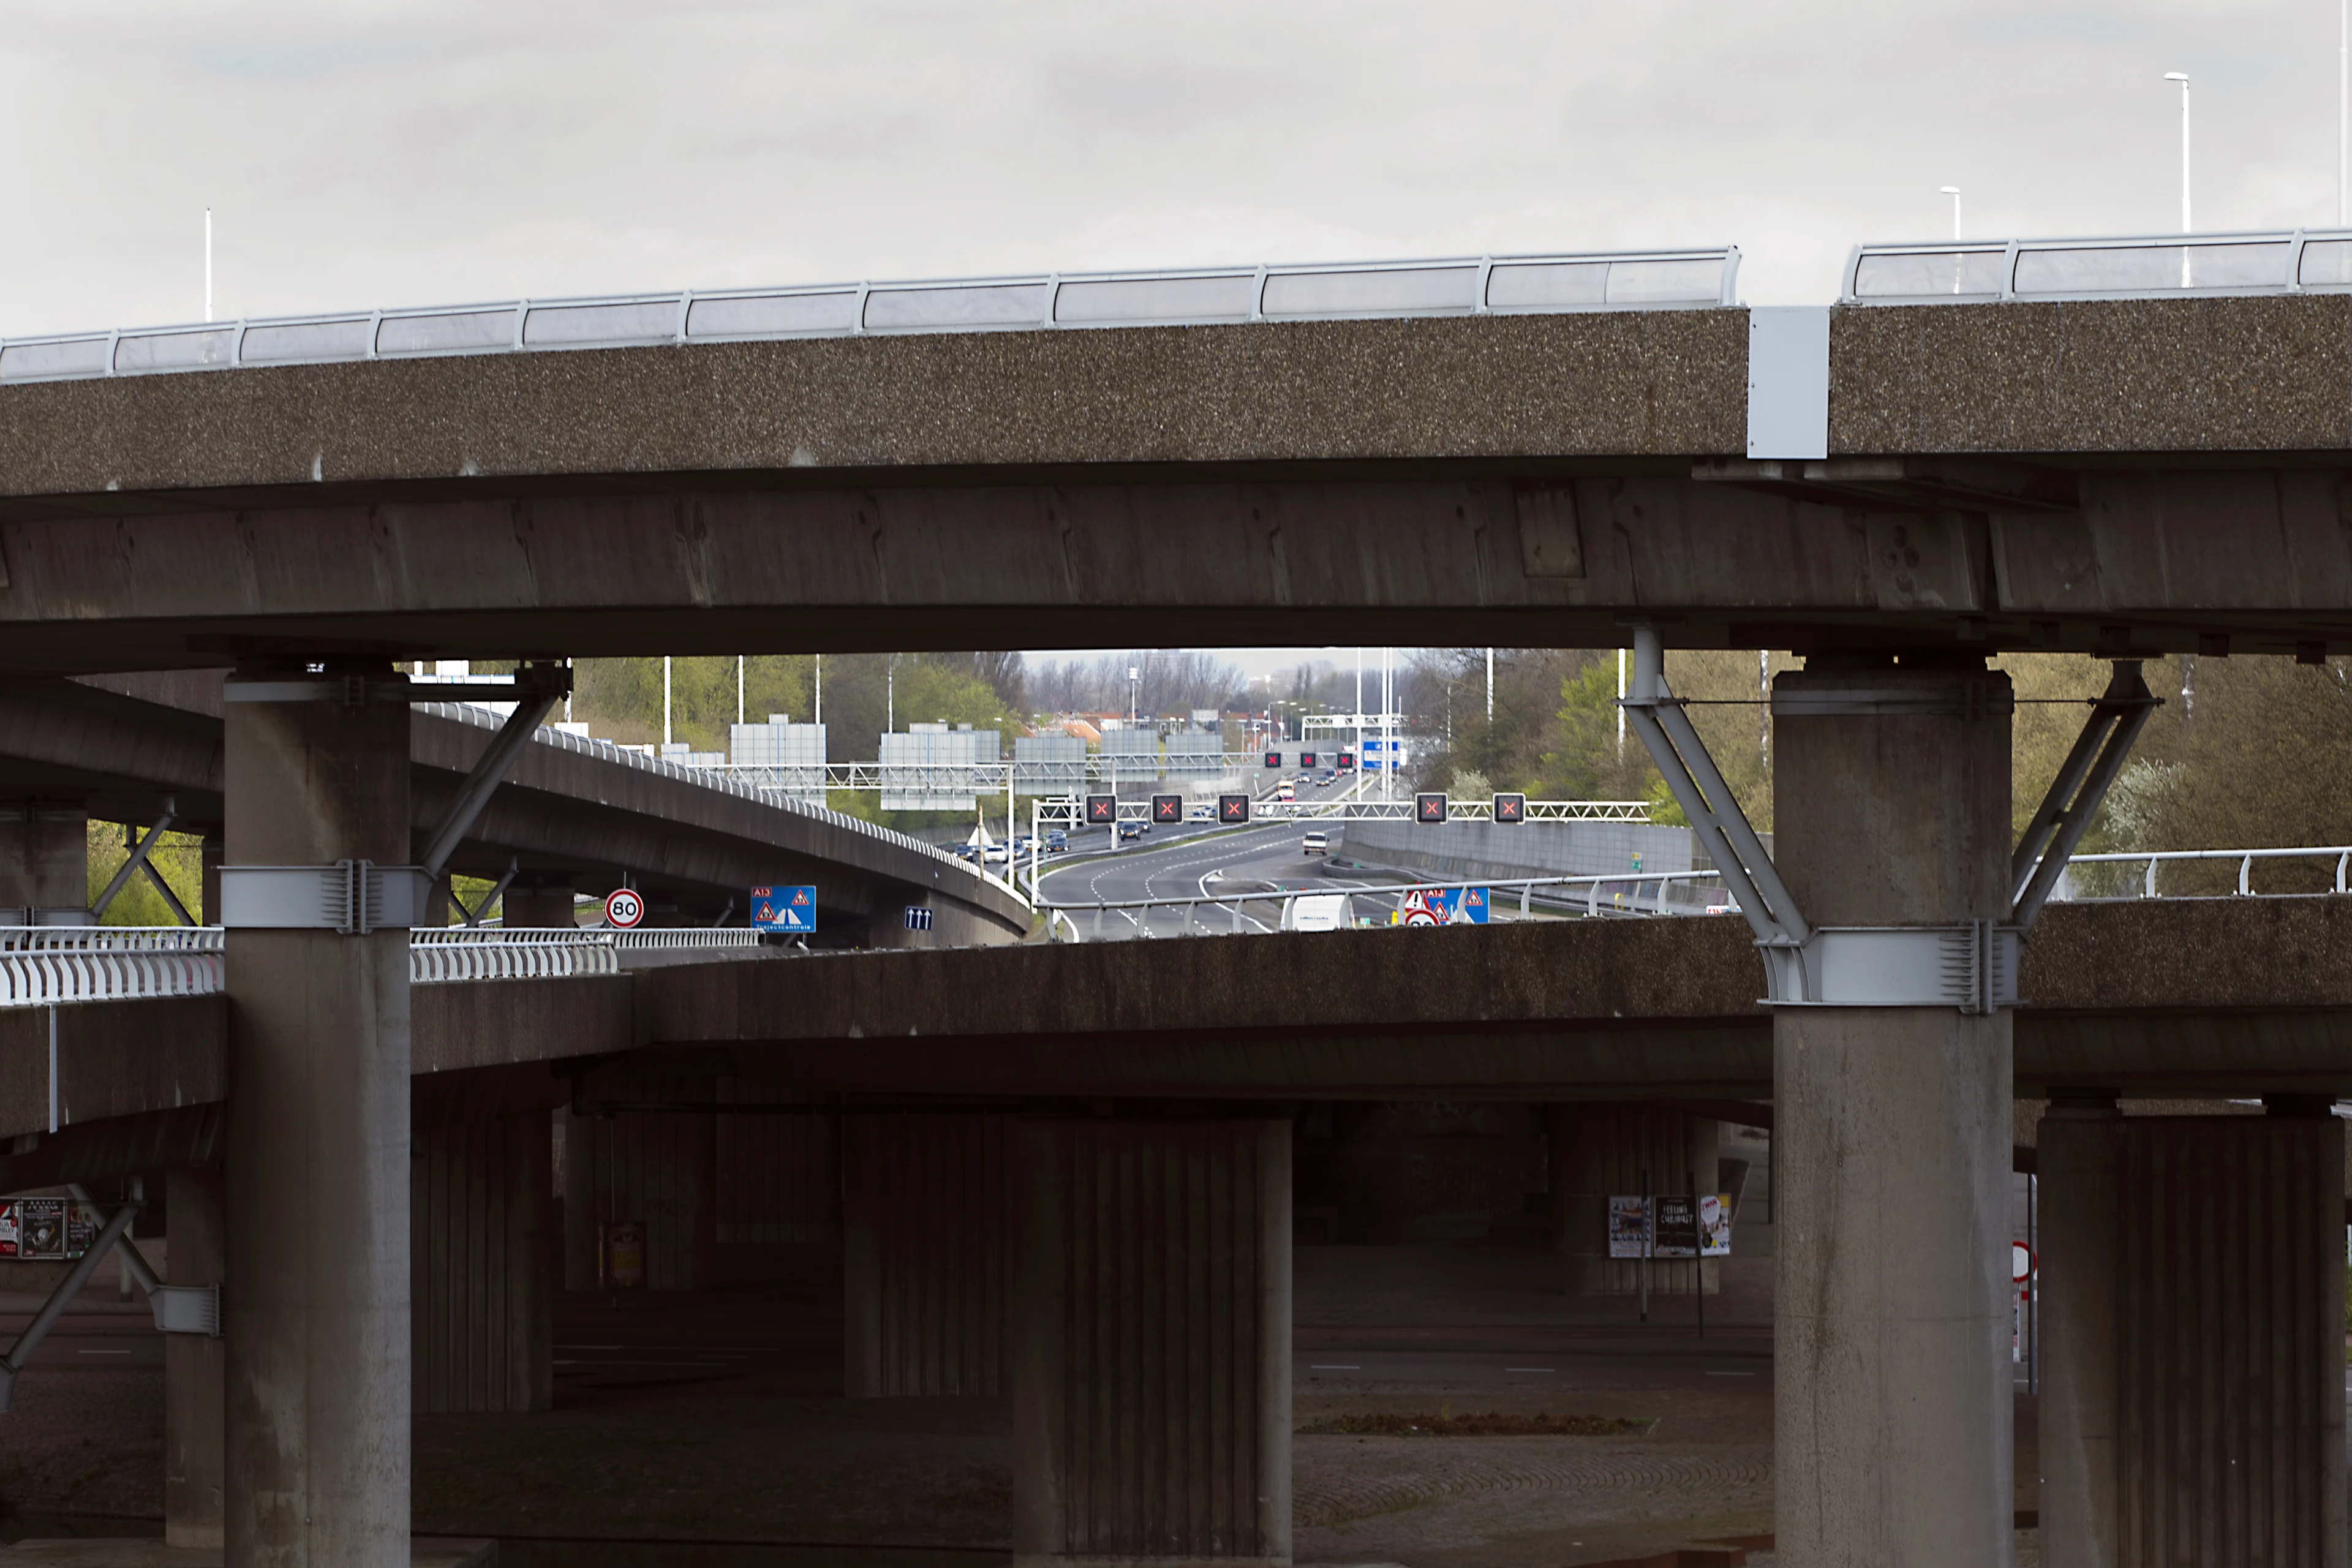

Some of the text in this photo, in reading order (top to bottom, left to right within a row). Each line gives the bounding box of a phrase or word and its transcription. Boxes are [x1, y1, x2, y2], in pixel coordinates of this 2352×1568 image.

[754, 888, 770, 897] A13
[613, 902, 636, 916] 80
[1663, 1204, 1687, 1215] FEELING
